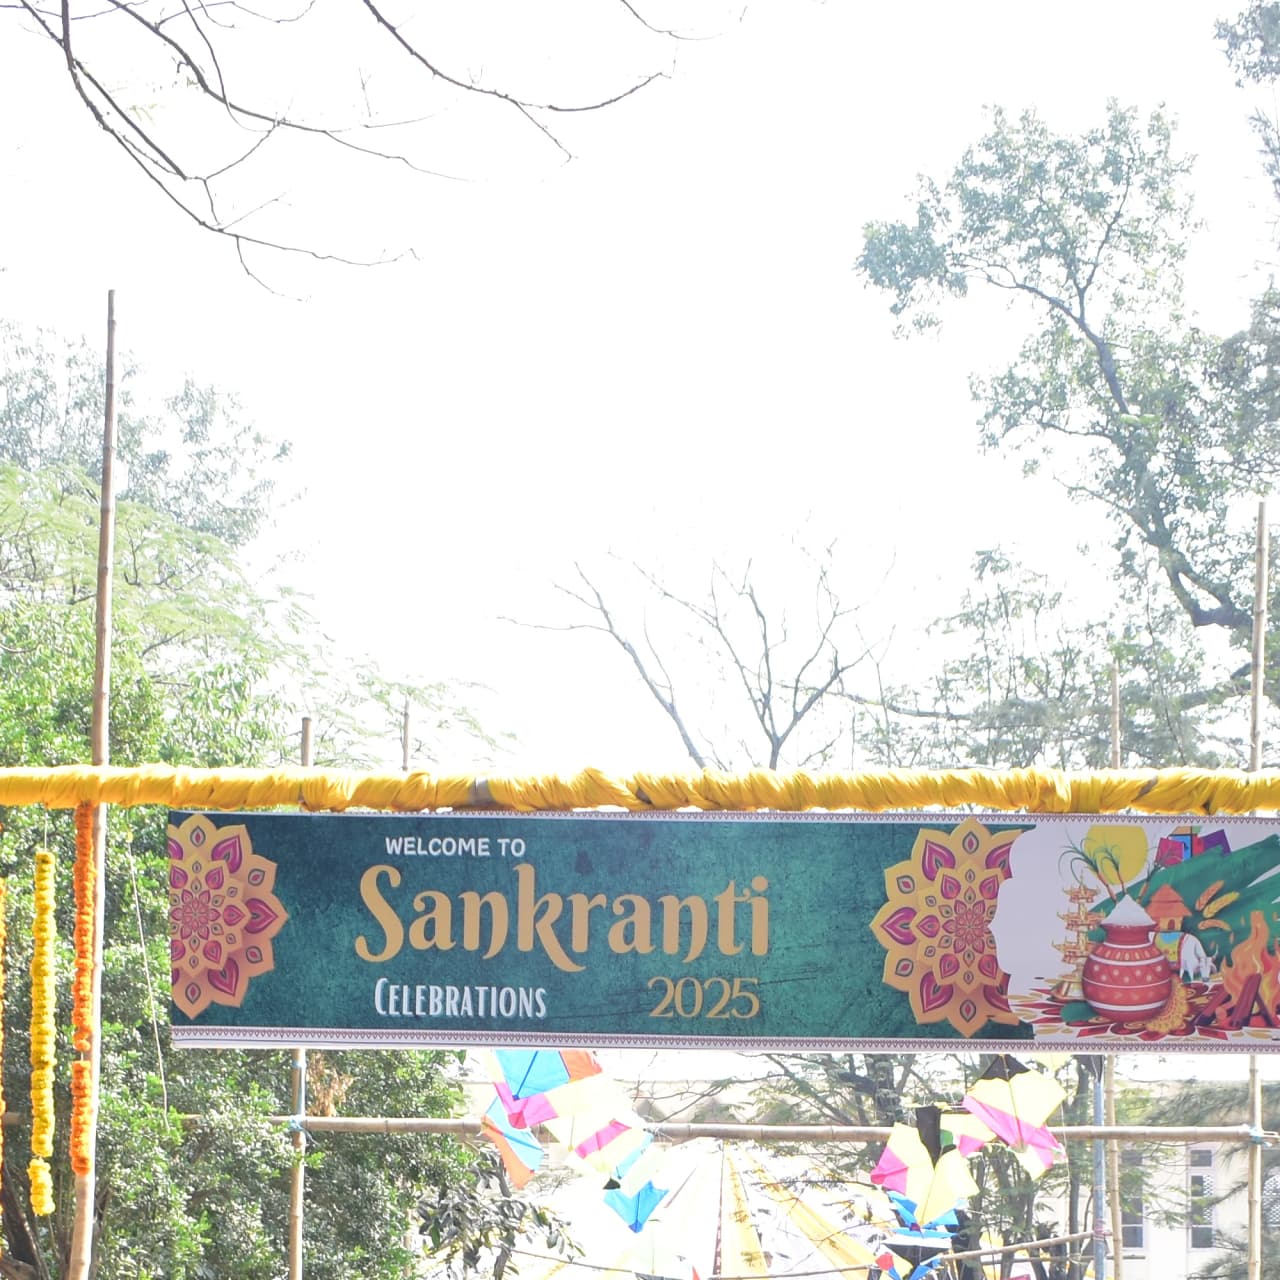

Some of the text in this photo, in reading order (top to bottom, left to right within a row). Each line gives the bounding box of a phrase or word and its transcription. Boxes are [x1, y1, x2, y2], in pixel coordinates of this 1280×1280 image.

[385, 836, 526, 857] WELCOME TO
[354, 863, 770, 972] Sankranti
[374, 977, 547, 1018] CELEBRATIONS
[647, 976, 761, 1019] 2025
